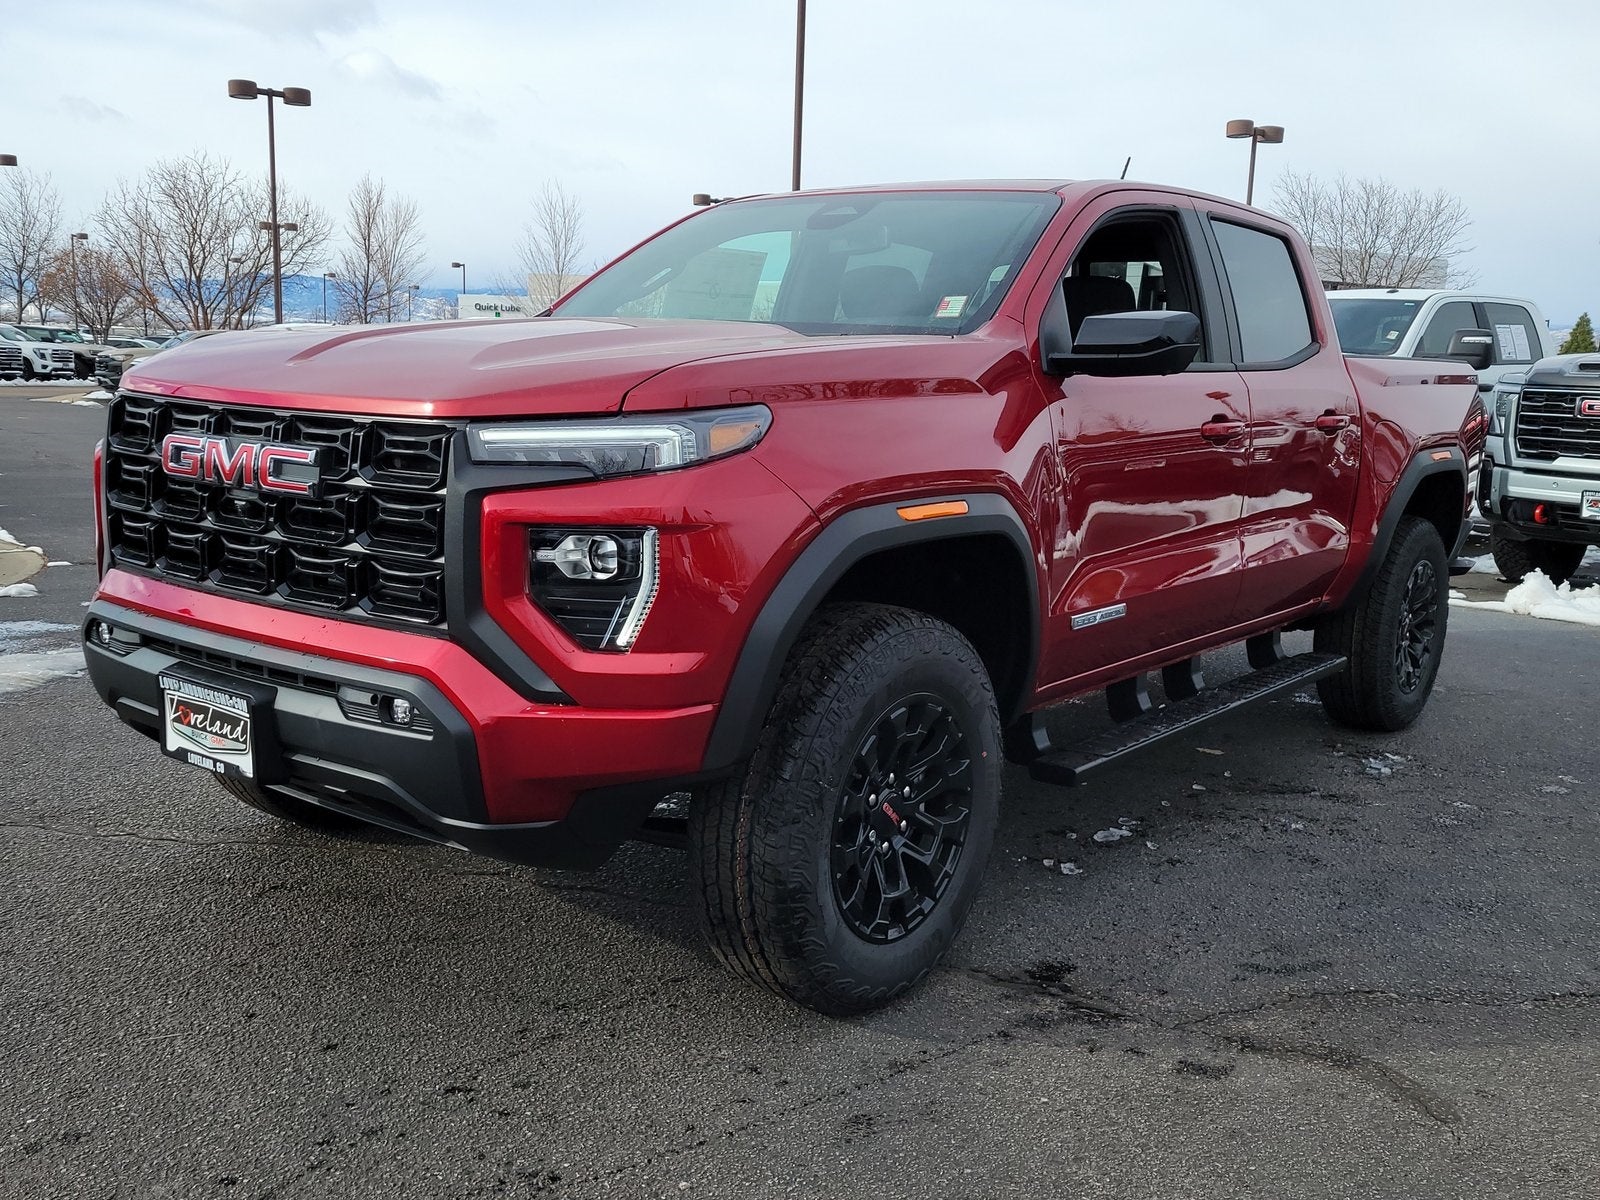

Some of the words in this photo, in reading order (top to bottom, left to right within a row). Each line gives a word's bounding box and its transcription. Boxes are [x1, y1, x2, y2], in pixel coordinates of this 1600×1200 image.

[474, 302, 499, 311] Quick
[500, 303, 521, 312] Lube
[161, 433, 317, 498] GMC
[169, 695, 247, 741] Loveland
[191, 729, 209, 740] BUICK
[210, 736, 226, 747] GMC
